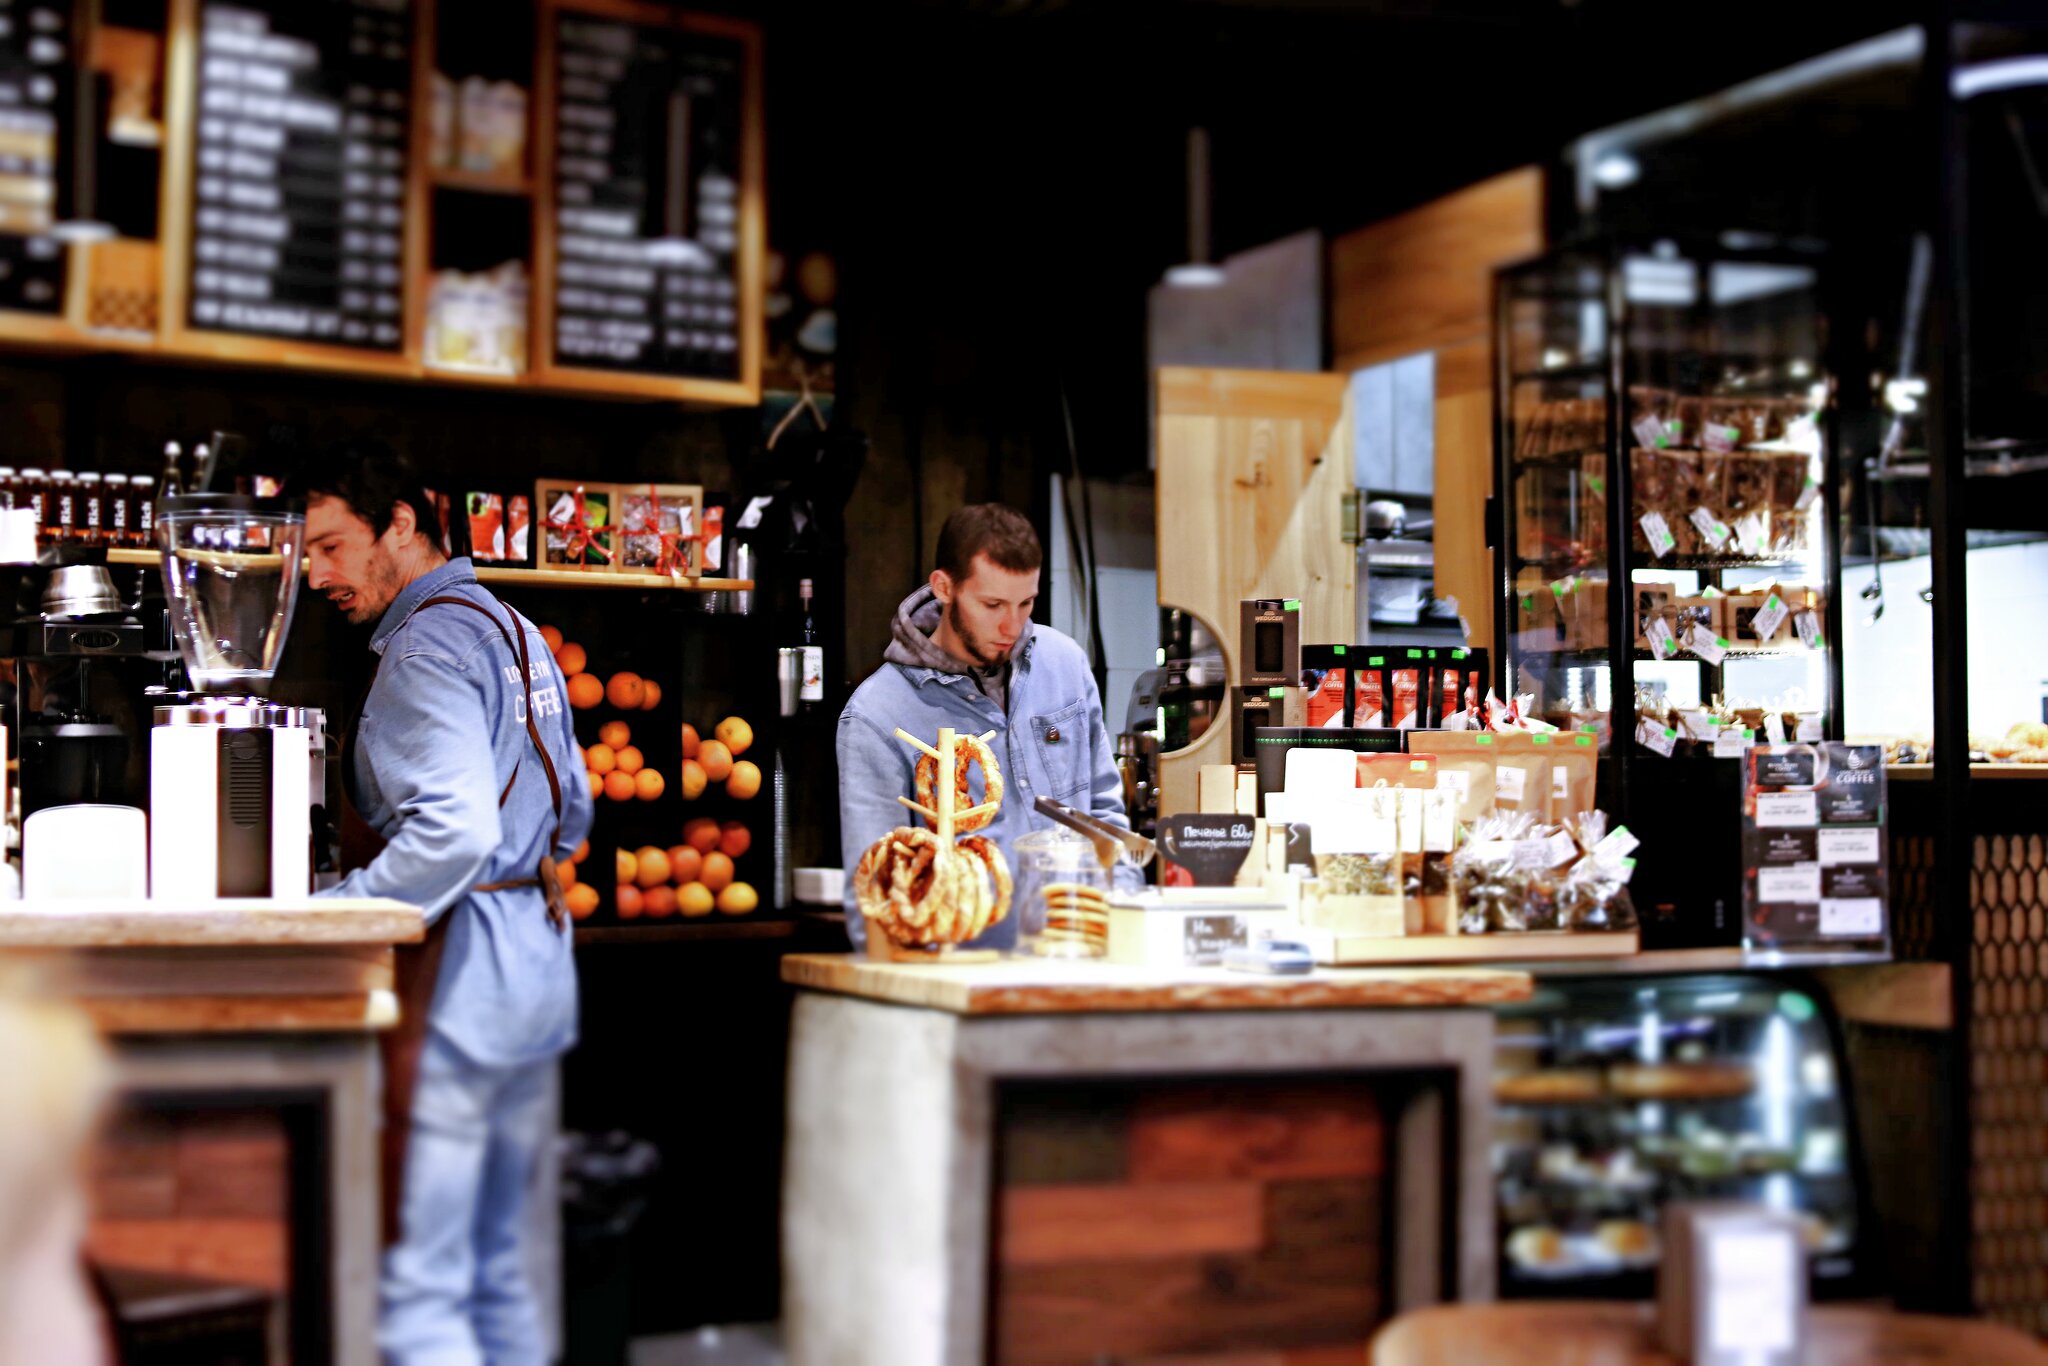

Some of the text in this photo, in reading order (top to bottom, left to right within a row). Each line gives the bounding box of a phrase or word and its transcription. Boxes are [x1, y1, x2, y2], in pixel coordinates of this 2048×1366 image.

[60, 496, 72, 524] Rich
[88, 498, 99, 526] Rich
[114, 499, 126, 527] Rich
[141, 501, 153, 529] Rich
[1836, 773, 1875, 784] COFFEE
[1183, 826, 1226, 838] Печенье
